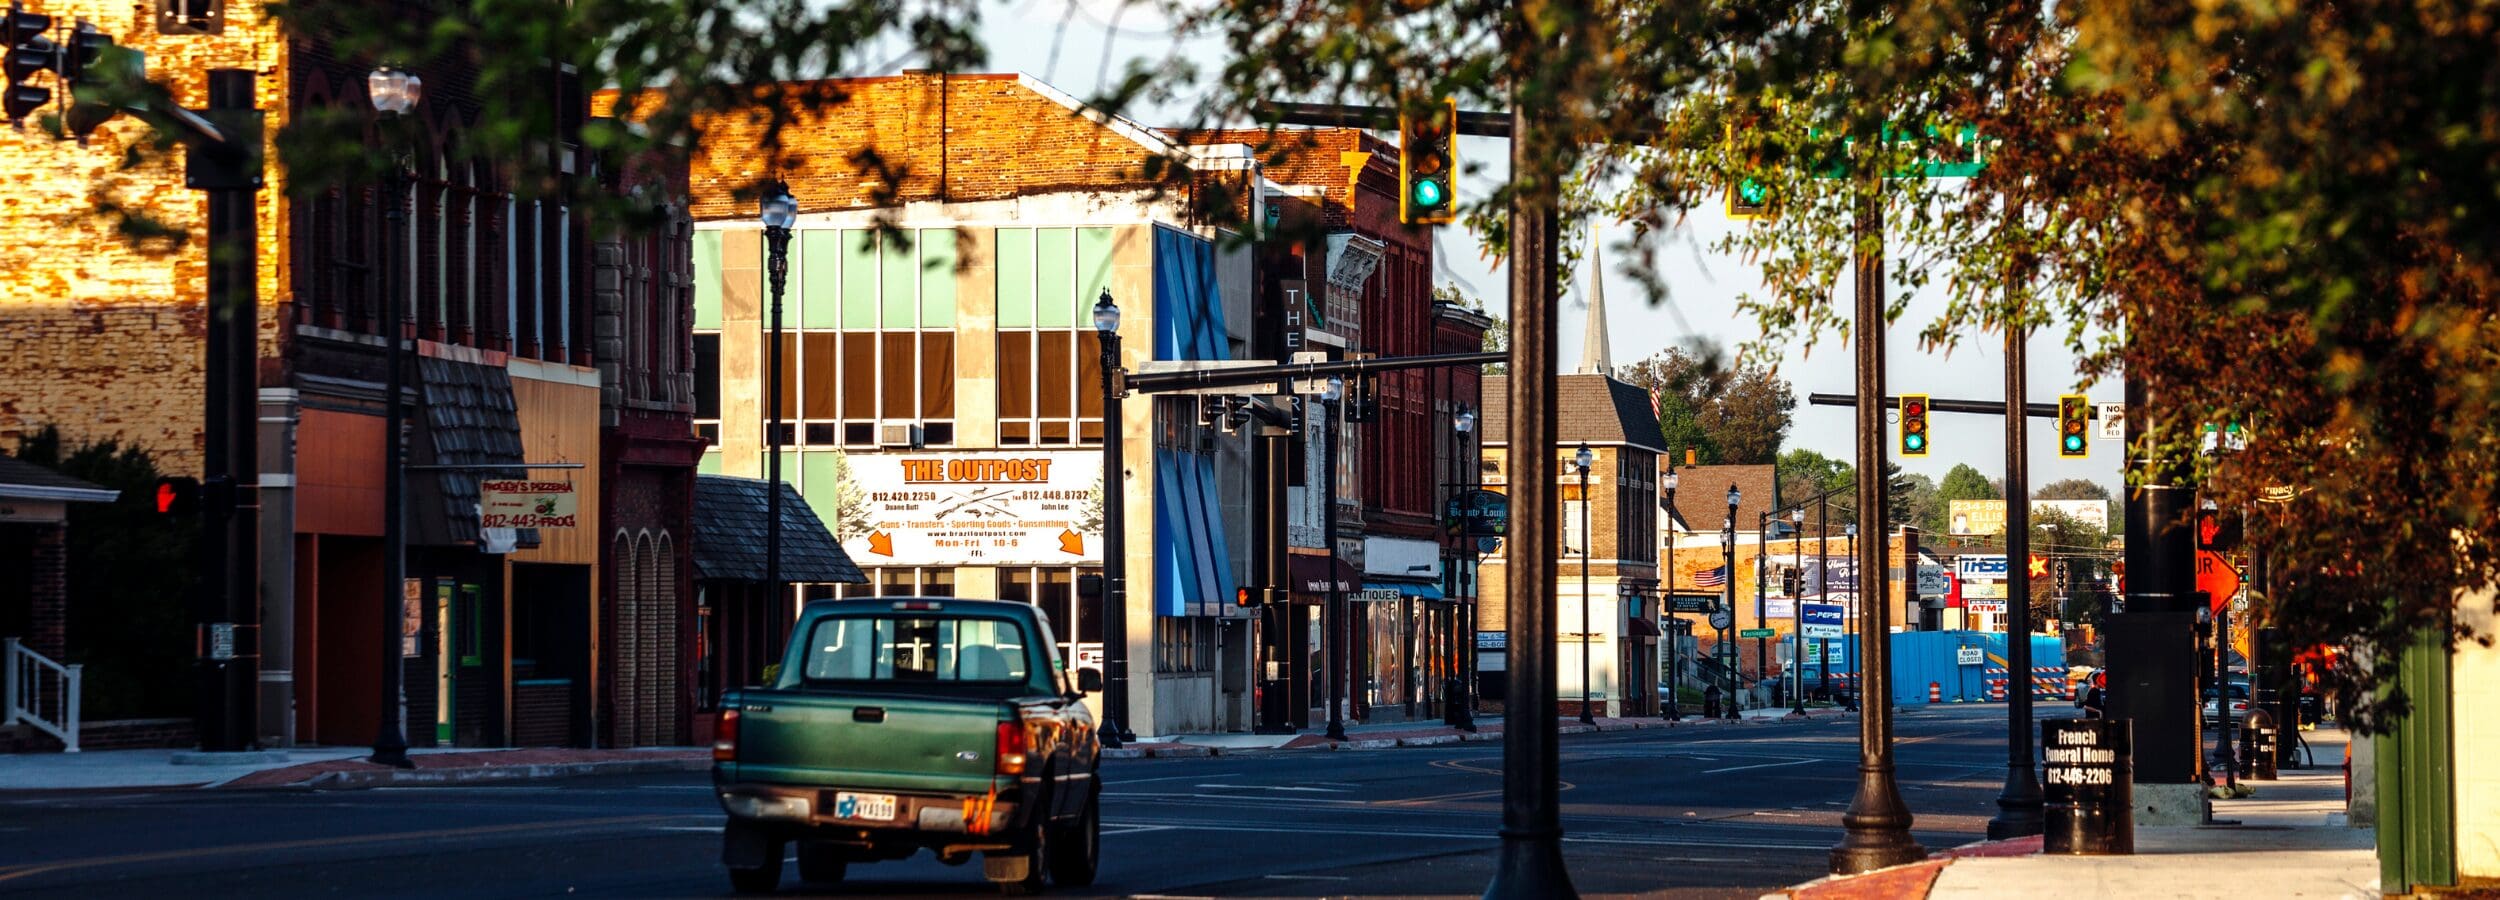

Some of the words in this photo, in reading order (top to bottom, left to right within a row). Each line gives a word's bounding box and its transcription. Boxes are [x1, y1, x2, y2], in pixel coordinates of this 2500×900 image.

[1286, 289, 1301, 433] THERE
[901, 459, 944, 482] THE
[948, 458, 1052, 481] OUTPOST
[872, 492, 936, 502] 812.420.2250
[1022, 490, 1089, 500] 812.448.8732
[483, 514, 575, 528] 812-443-FROG
[1972, 512, 2003, 521] ELLIS
[951, 521, 985, 529] Sporting
[1018, 520, 1069, 529] Gunsmithing
[1350, 590, 1399, 600] ANTIQUES
[2058, 728, 2097, 745] French
[2045, 746, 2081, 763] Funeral
[2082, 746, 2116, 763] Home
